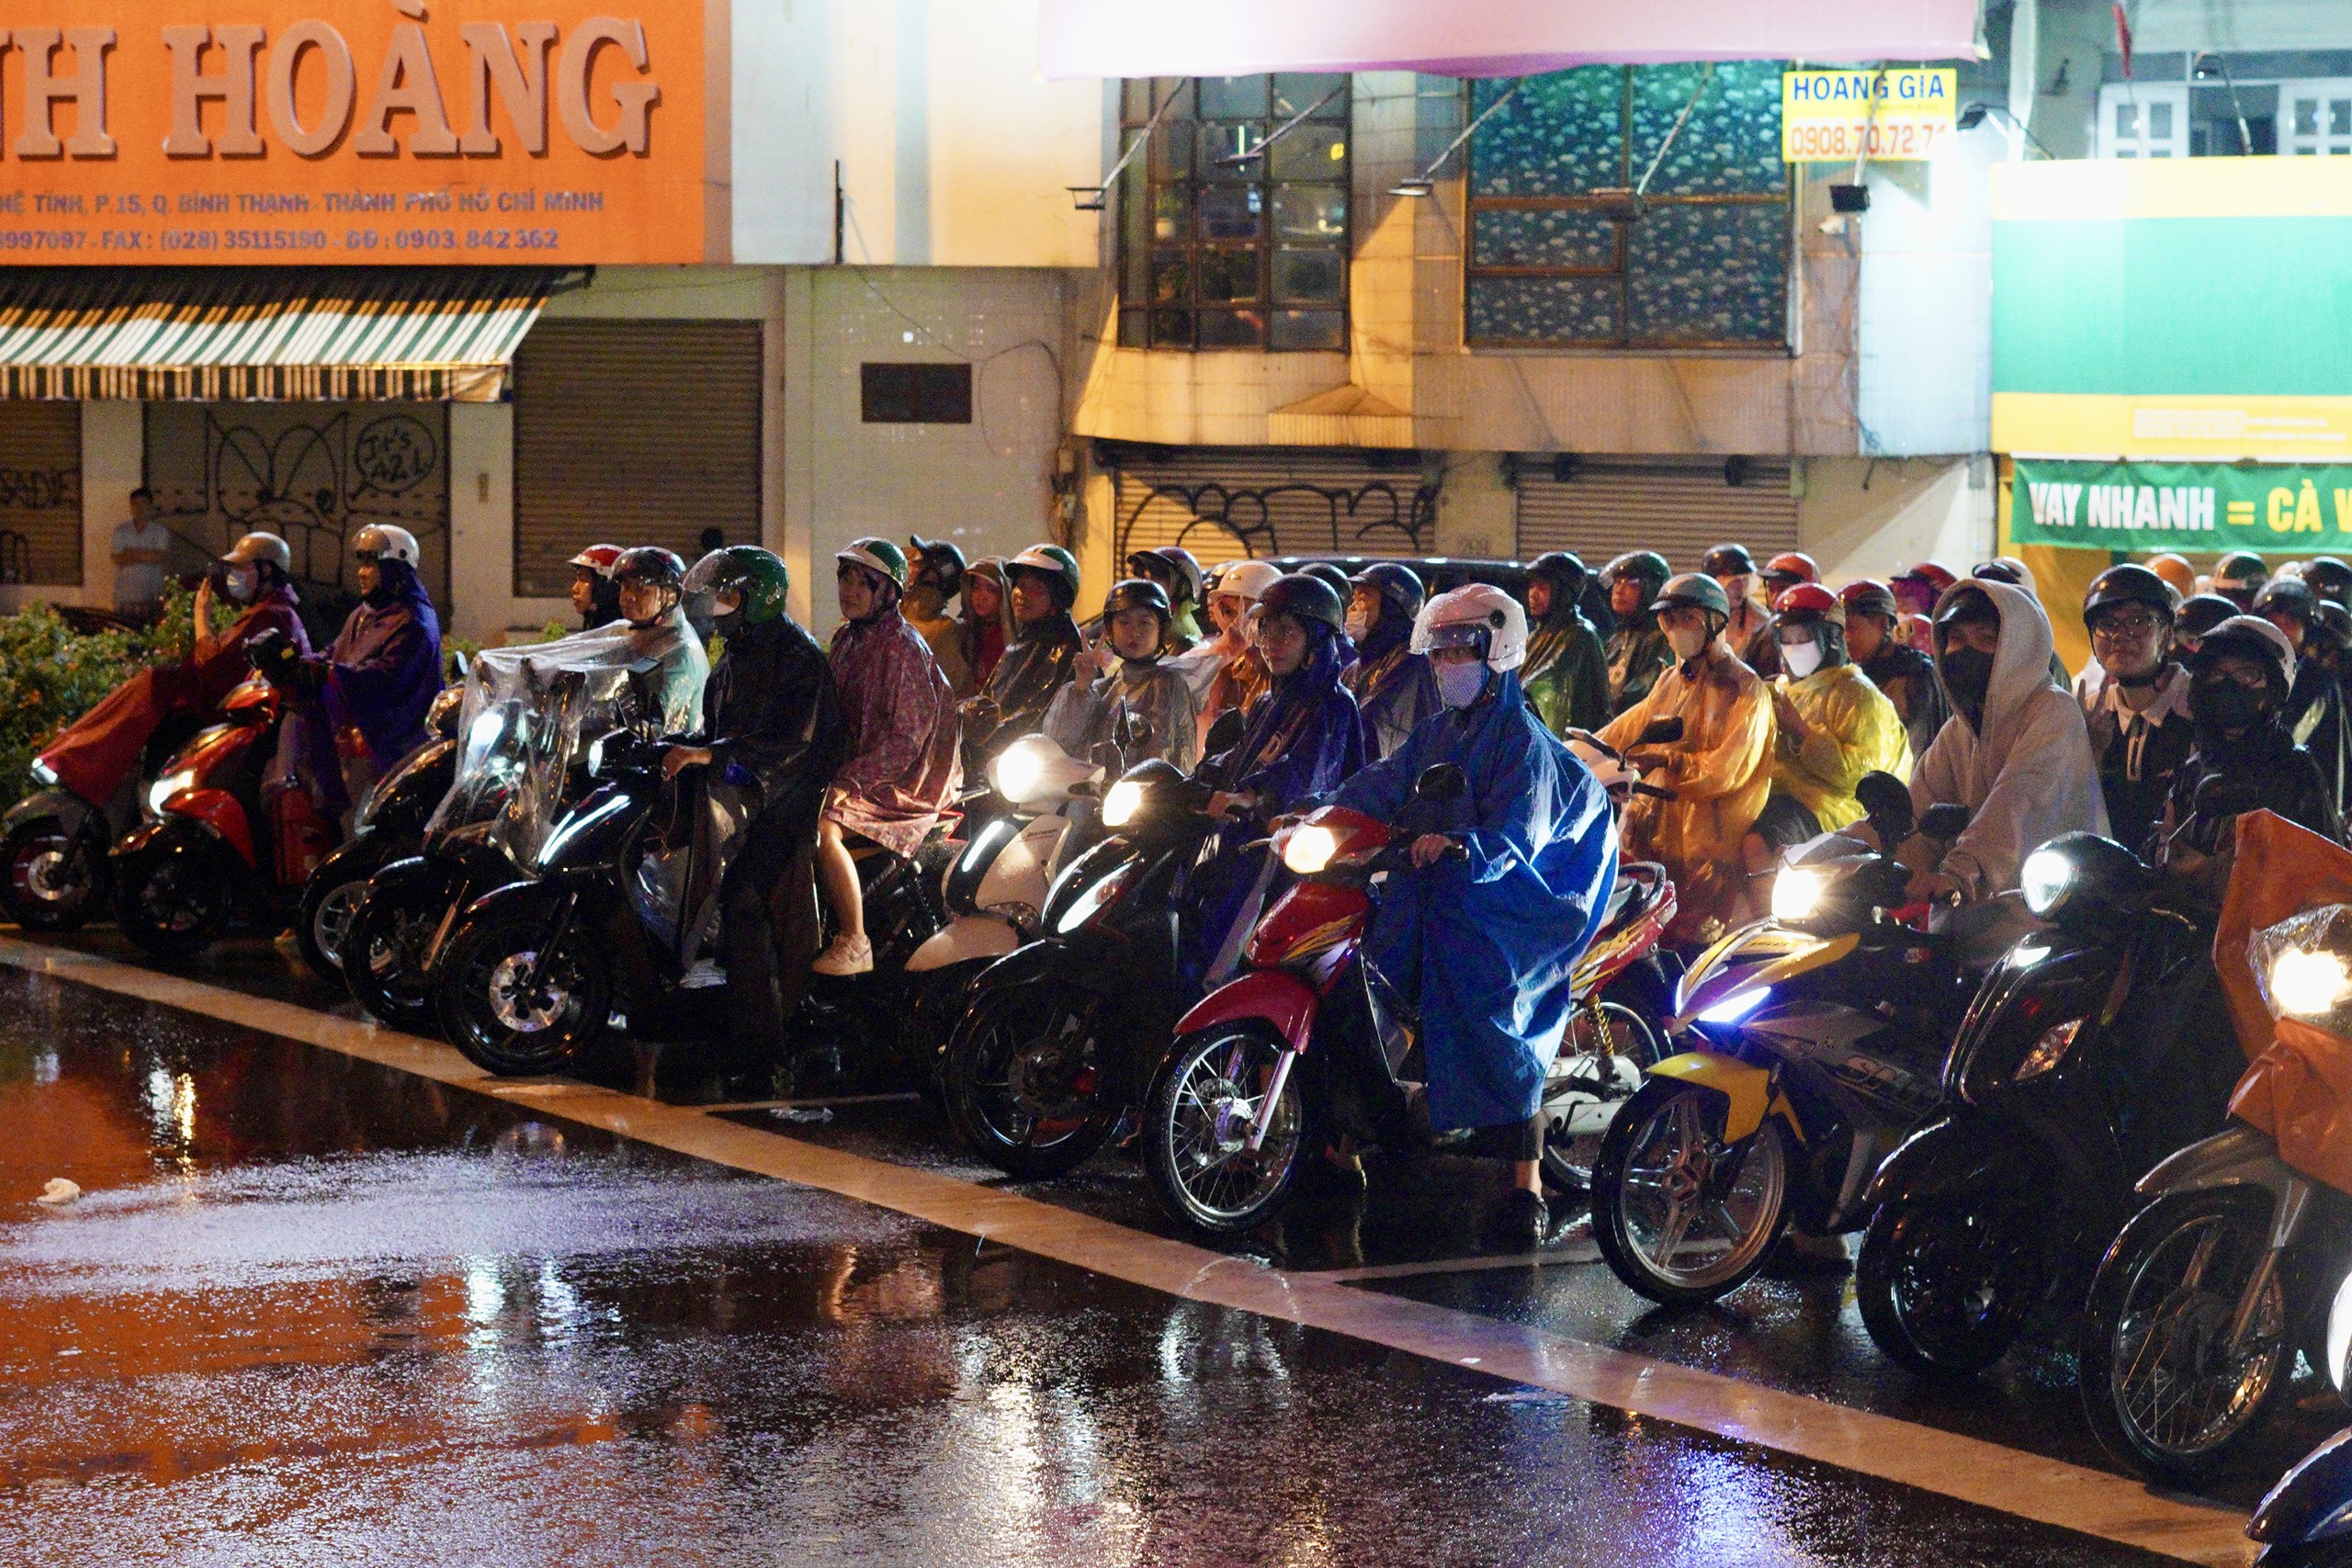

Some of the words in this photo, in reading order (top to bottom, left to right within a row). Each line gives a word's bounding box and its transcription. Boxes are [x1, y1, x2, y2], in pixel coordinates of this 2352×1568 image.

[0, 26, 118, 158] H
[160, 0, 662, 158] HOÀNG
[1792, 76, 1889, 100] HOANG
[1899, 73, 1944, 99] GIA
[497, 186, 536, 213] CHÍ
[160, 229, 220, 252] (028)
[2028, 481, 2084, 527] VAY
[2087, 484, 2217, 532] NHANH
[2267, 478, 2324, 534] CÀ
